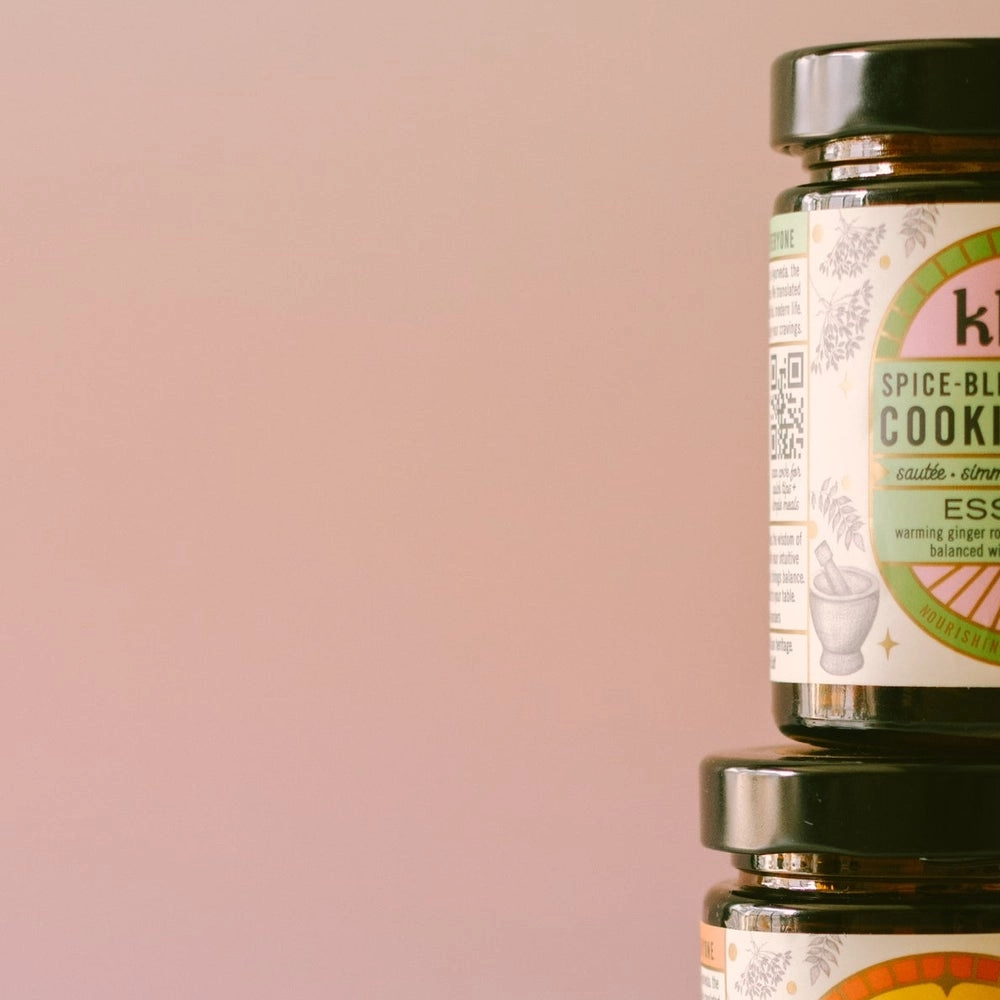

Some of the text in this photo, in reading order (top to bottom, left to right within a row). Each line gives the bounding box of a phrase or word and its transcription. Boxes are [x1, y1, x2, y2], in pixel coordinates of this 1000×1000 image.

[896, 463, 947, 482] sautée
[895, 526, 943, 542] warming
[948, 526, 985, 542] ginger
[930, 544, 983, 557] balanced
